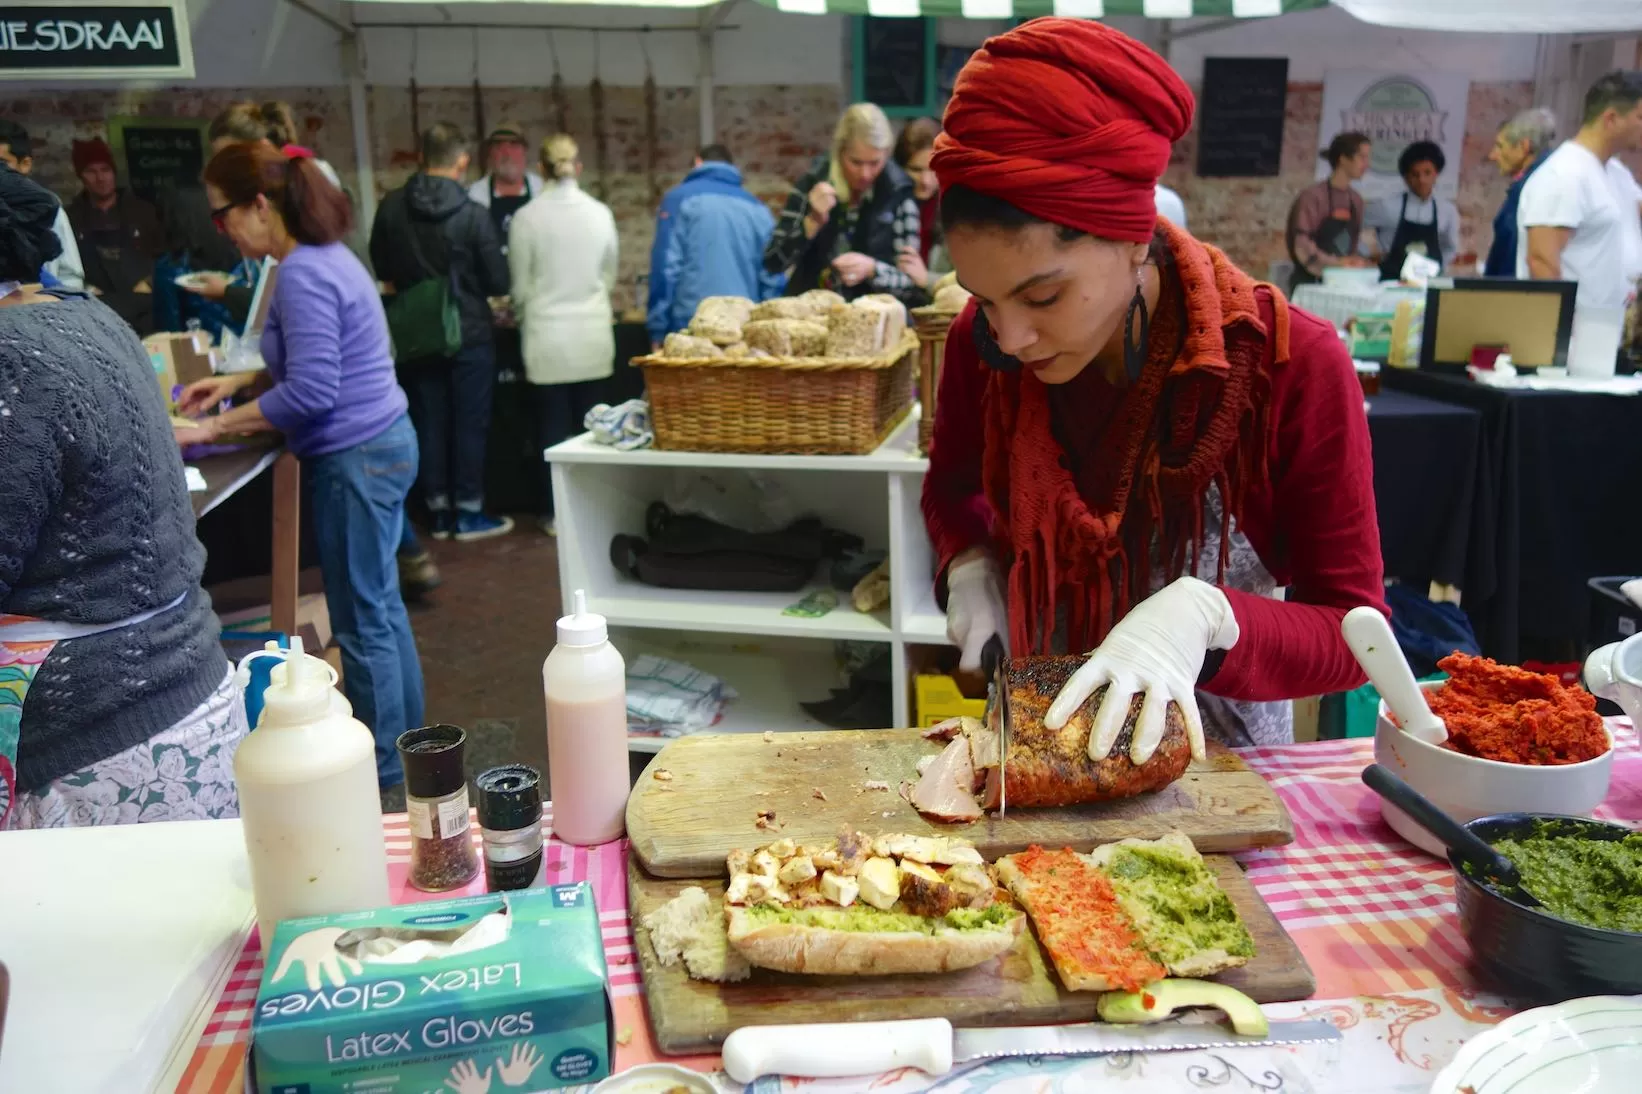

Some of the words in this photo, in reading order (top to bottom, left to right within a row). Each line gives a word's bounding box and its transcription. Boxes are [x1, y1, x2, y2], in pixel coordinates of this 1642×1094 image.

[419, 961, 522, 996] Latex
[260, 980, 406, 1019] Gloves
[325, 1029, 413, 1064] Latex
[421, 1010, 535, 1049] Gloves
